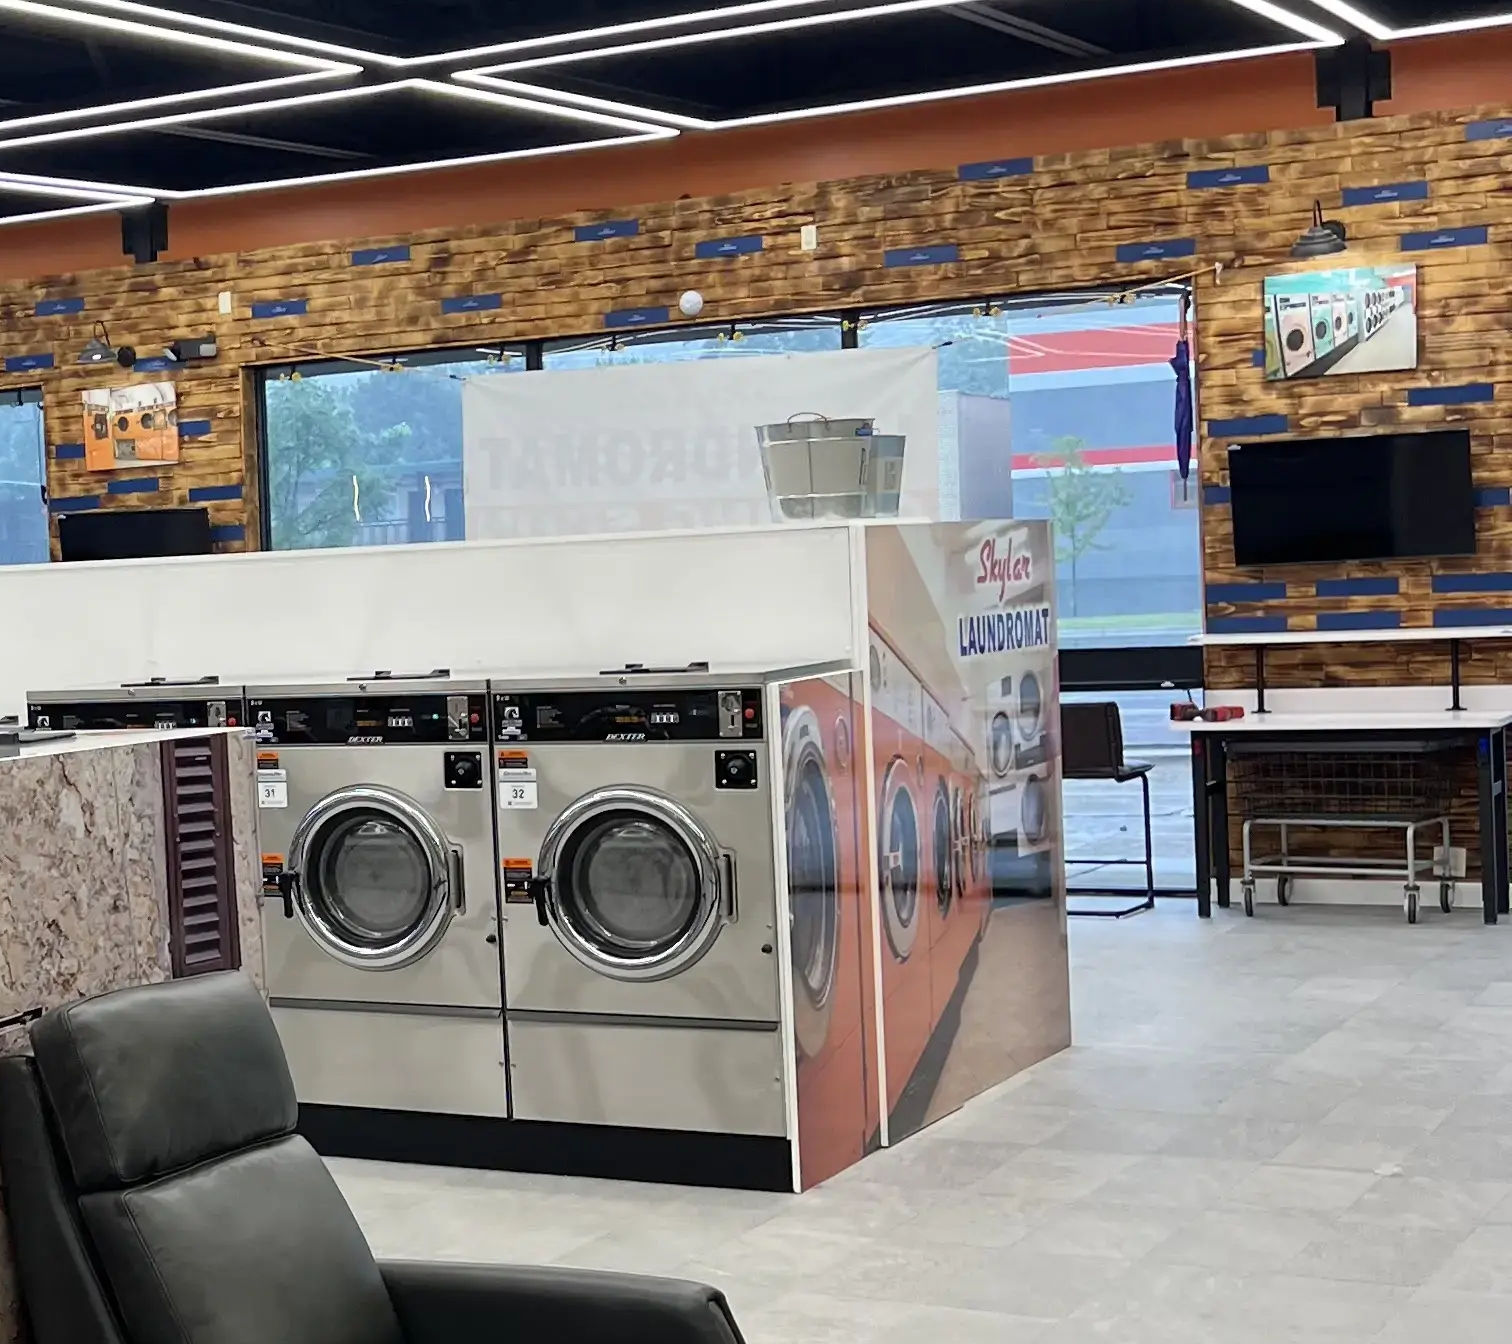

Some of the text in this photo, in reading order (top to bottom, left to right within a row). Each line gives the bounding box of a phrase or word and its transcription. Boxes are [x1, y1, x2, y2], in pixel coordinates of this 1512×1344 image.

[977, 537, 1030, 602] Skylar
[959, 608, 1049, 656] LAUNDROMAT
[605, 733, 646, 741] DEXTER
[264, 788, 276, 798] 31
[512, 788, 525, 799] 32
